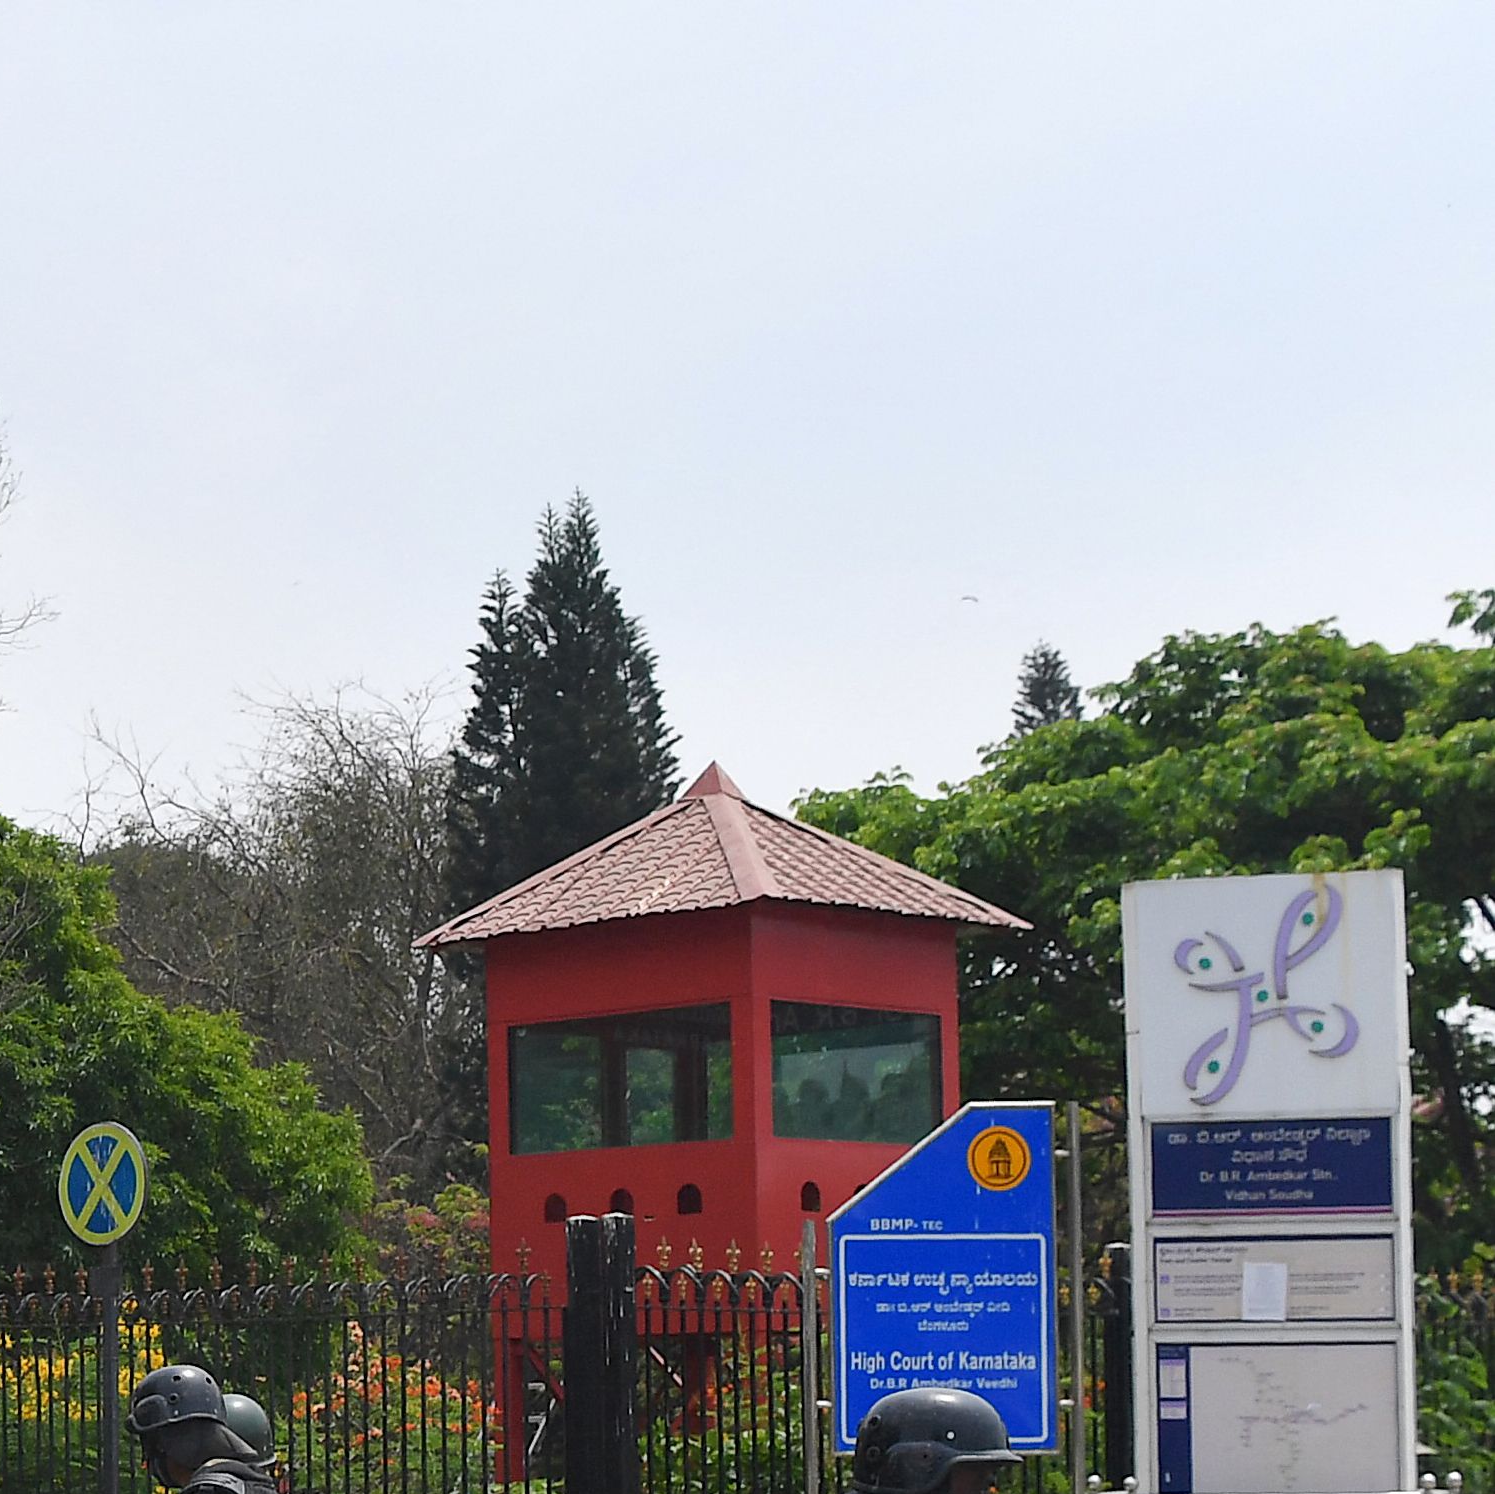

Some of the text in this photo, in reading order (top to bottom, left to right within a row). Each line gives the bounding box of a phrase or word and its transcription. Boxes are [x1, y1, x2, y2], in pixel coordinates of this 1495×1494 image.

[1247, 1170, 1308, 1181] Ambedkar
[922, 1220, 943, 1231] TEC
[848, 1271, 910, 1288] ಕರ್ನಾಟಕ
[950, 1271, 1038, 1295] ನ್ಯಾಯಾಲಯ
[851, 1351, 1036, 1374] High Court of Karnataka
